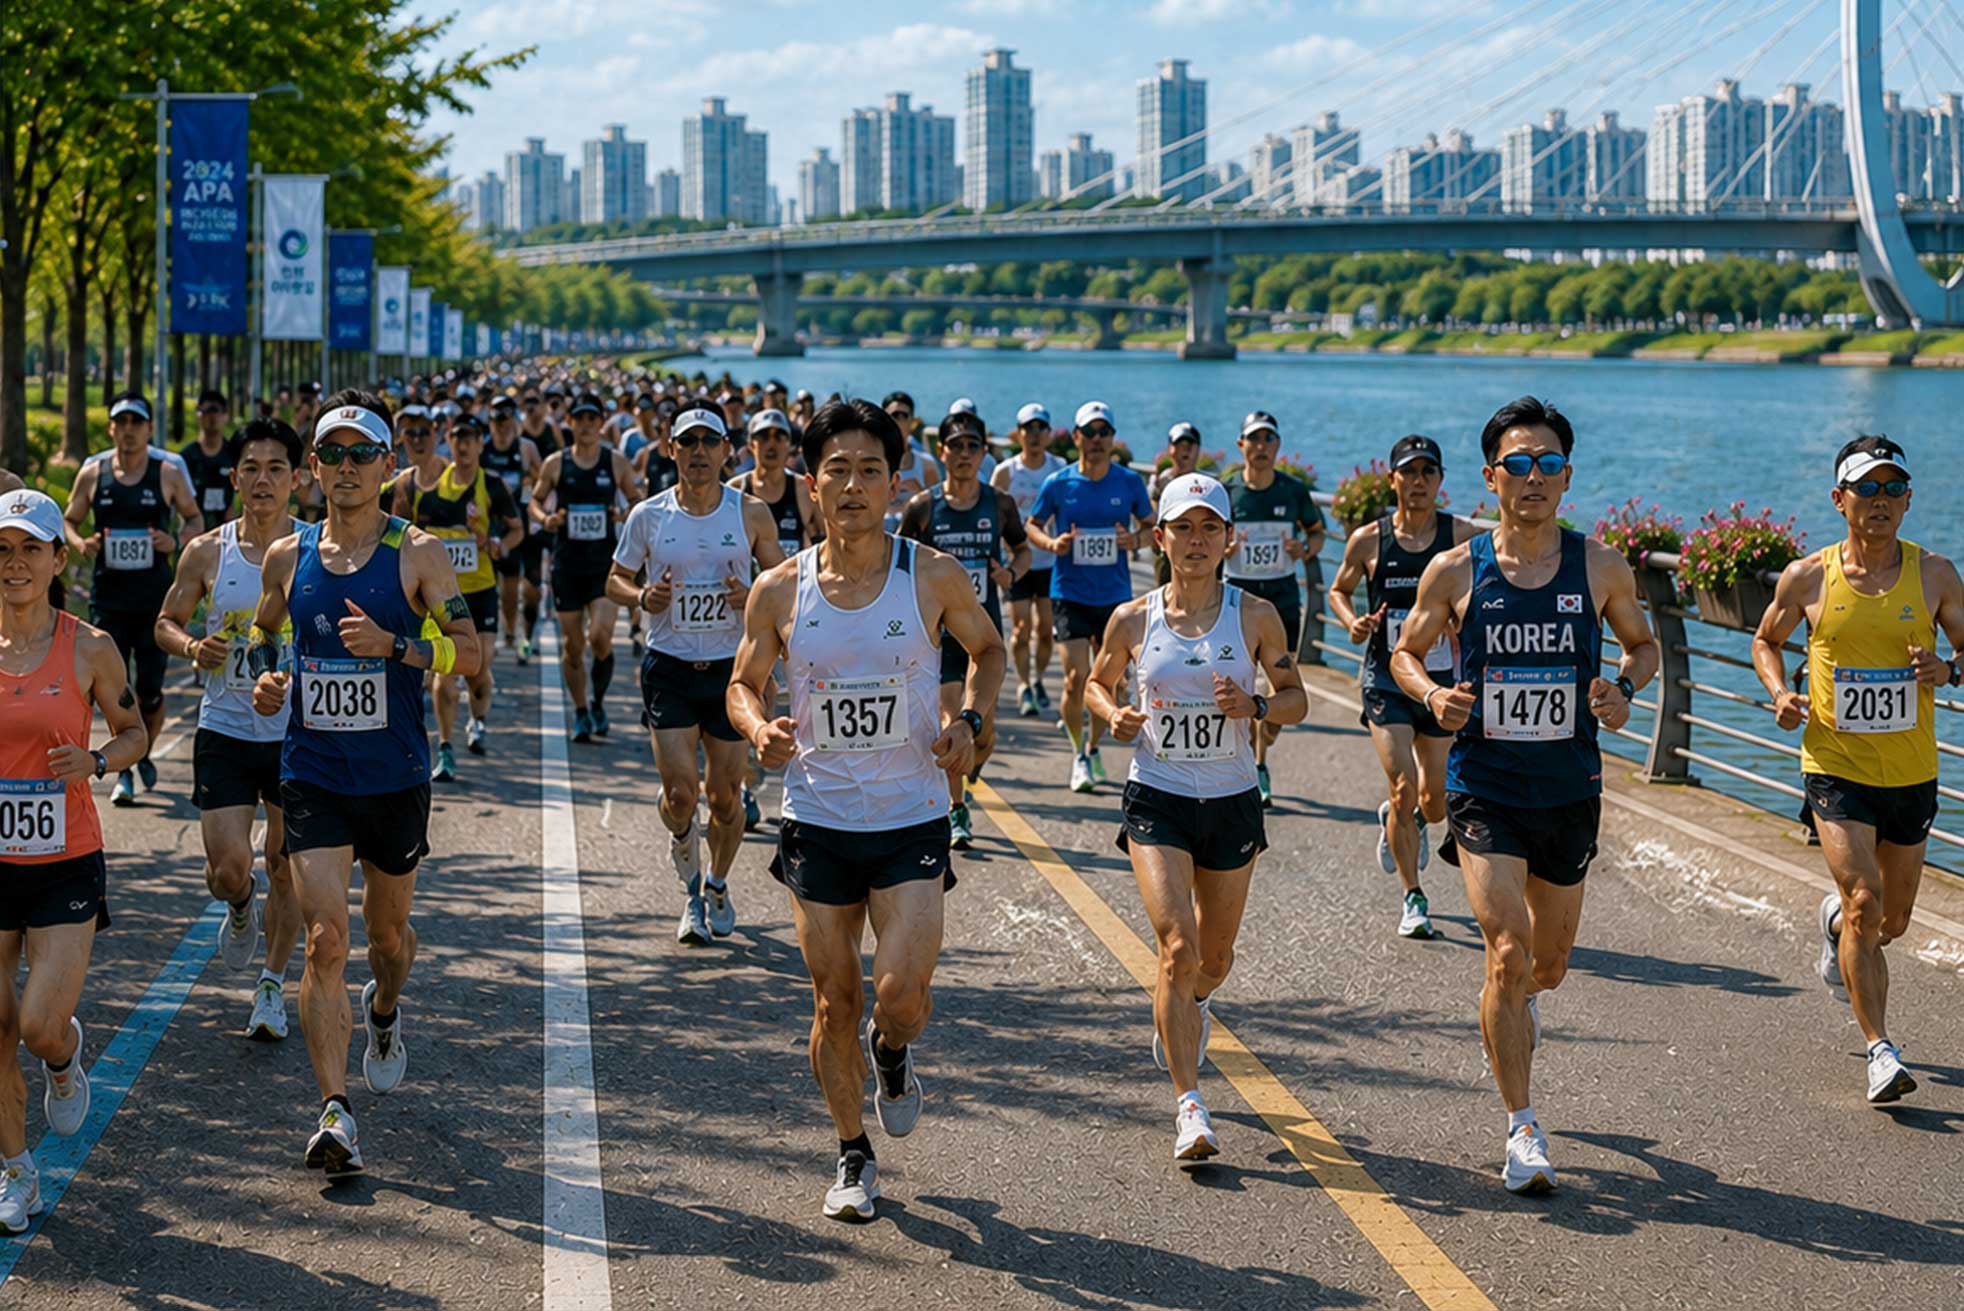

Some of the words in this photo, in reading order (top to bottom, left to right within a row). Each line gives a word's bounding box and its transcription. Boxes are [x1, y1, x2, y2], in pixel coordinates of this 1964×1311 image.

[183, 181, 234, 203] APA
[677, 593, 726, 622] 1222
[1485, 623, 1576, 654] KOREA
[309, 679, 377, 717] 2038
[1493, 688, 1566, 726] 1478
[1843, 686, 1907, 721] 2031
[821, 695, 897, 738] 1357
[1161, 714, 1227, 749] 2187
[0, 800, 55, 841] 056
